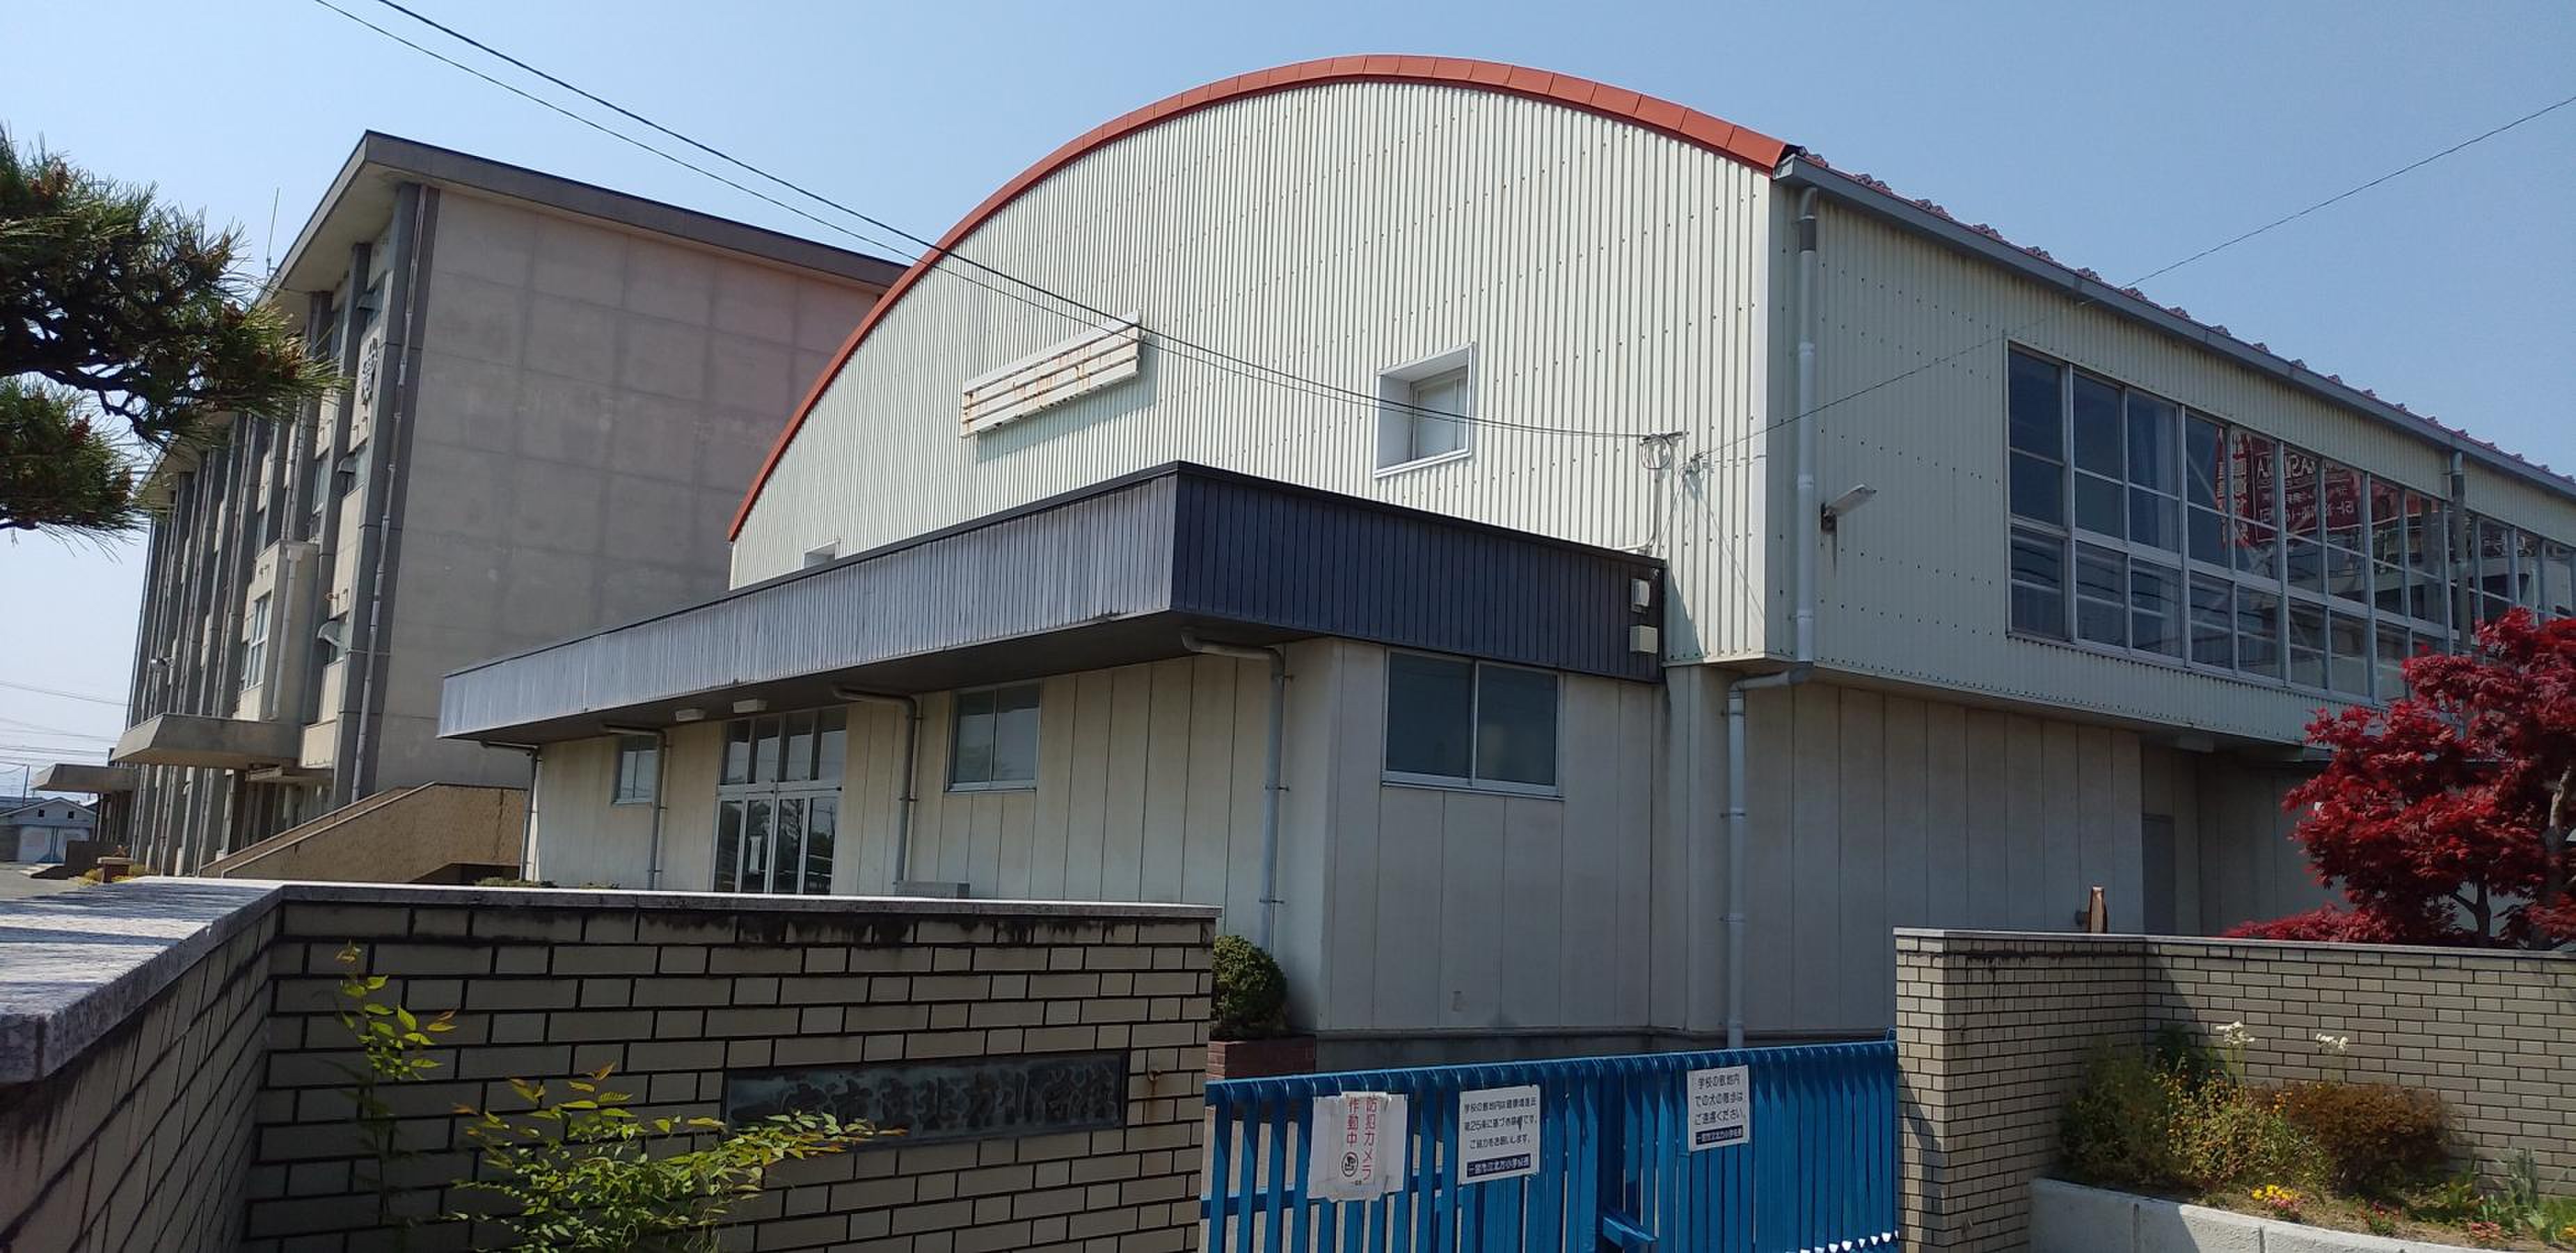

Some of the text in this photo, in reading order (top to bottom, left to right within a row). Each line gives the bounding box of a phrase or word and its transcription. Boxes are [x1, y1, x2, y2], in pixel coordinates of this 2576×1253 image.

[1697, 1073, 1740, 1089] 学校の敷地内
[1694, 1092, 1743, 1107] での犬の散歩は
[1346, 1096, 1359, 1147] 作動中
[1694, 1108, 1746, 1125] ご遠慮ください。
[1361, 1096, 1378, 1181] 防犯カメラ
[1470, 1135, 1530, 1150] ご協力をお願いします。
